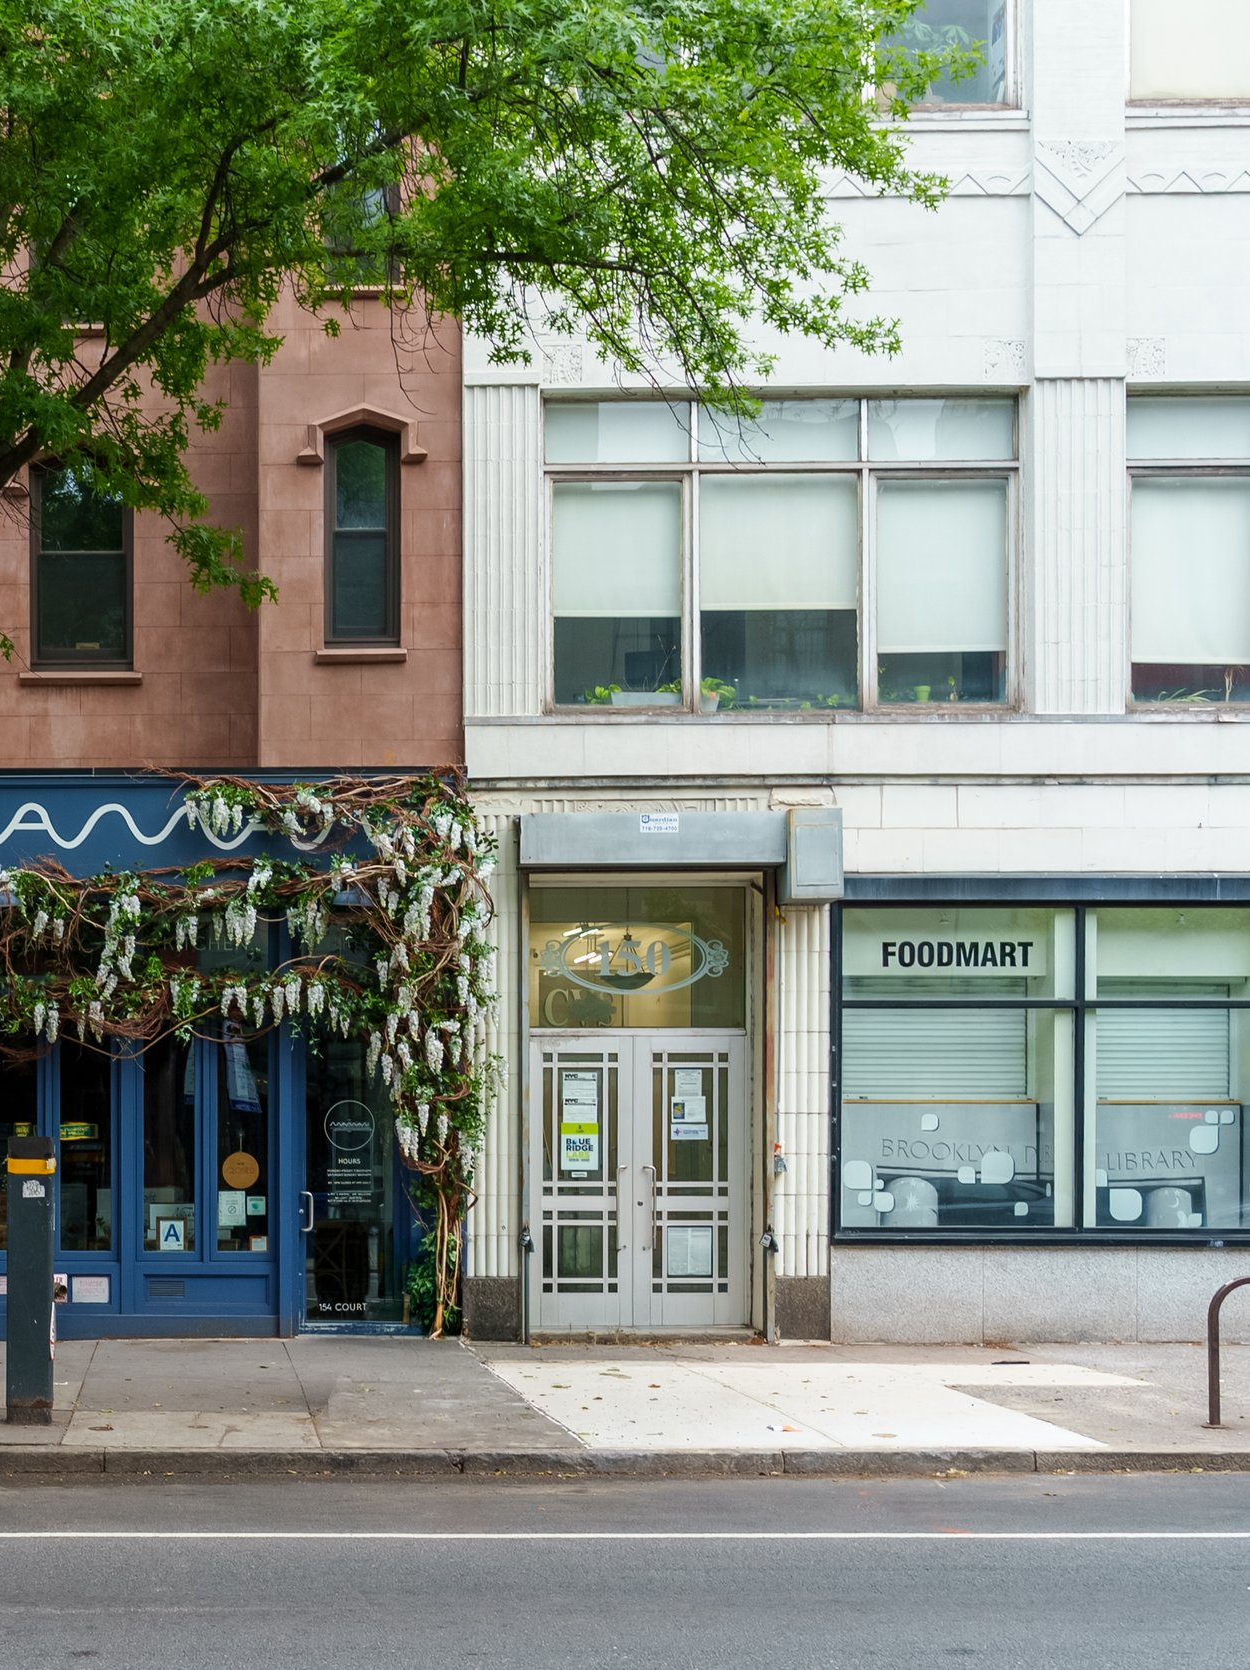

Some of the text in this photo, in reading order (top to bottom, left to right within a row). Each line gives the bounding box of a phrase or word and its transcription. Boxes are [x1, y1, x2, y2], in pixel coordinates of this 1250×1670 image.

[594, 940, 672, 977] 150
[881, 941, 1034, 968] FOODMART
[1106, 1150, 1197, 1171] LIBRARY
[163, 1223, 181, 1242] A
[334, 1302, 368, 1311] COURT
